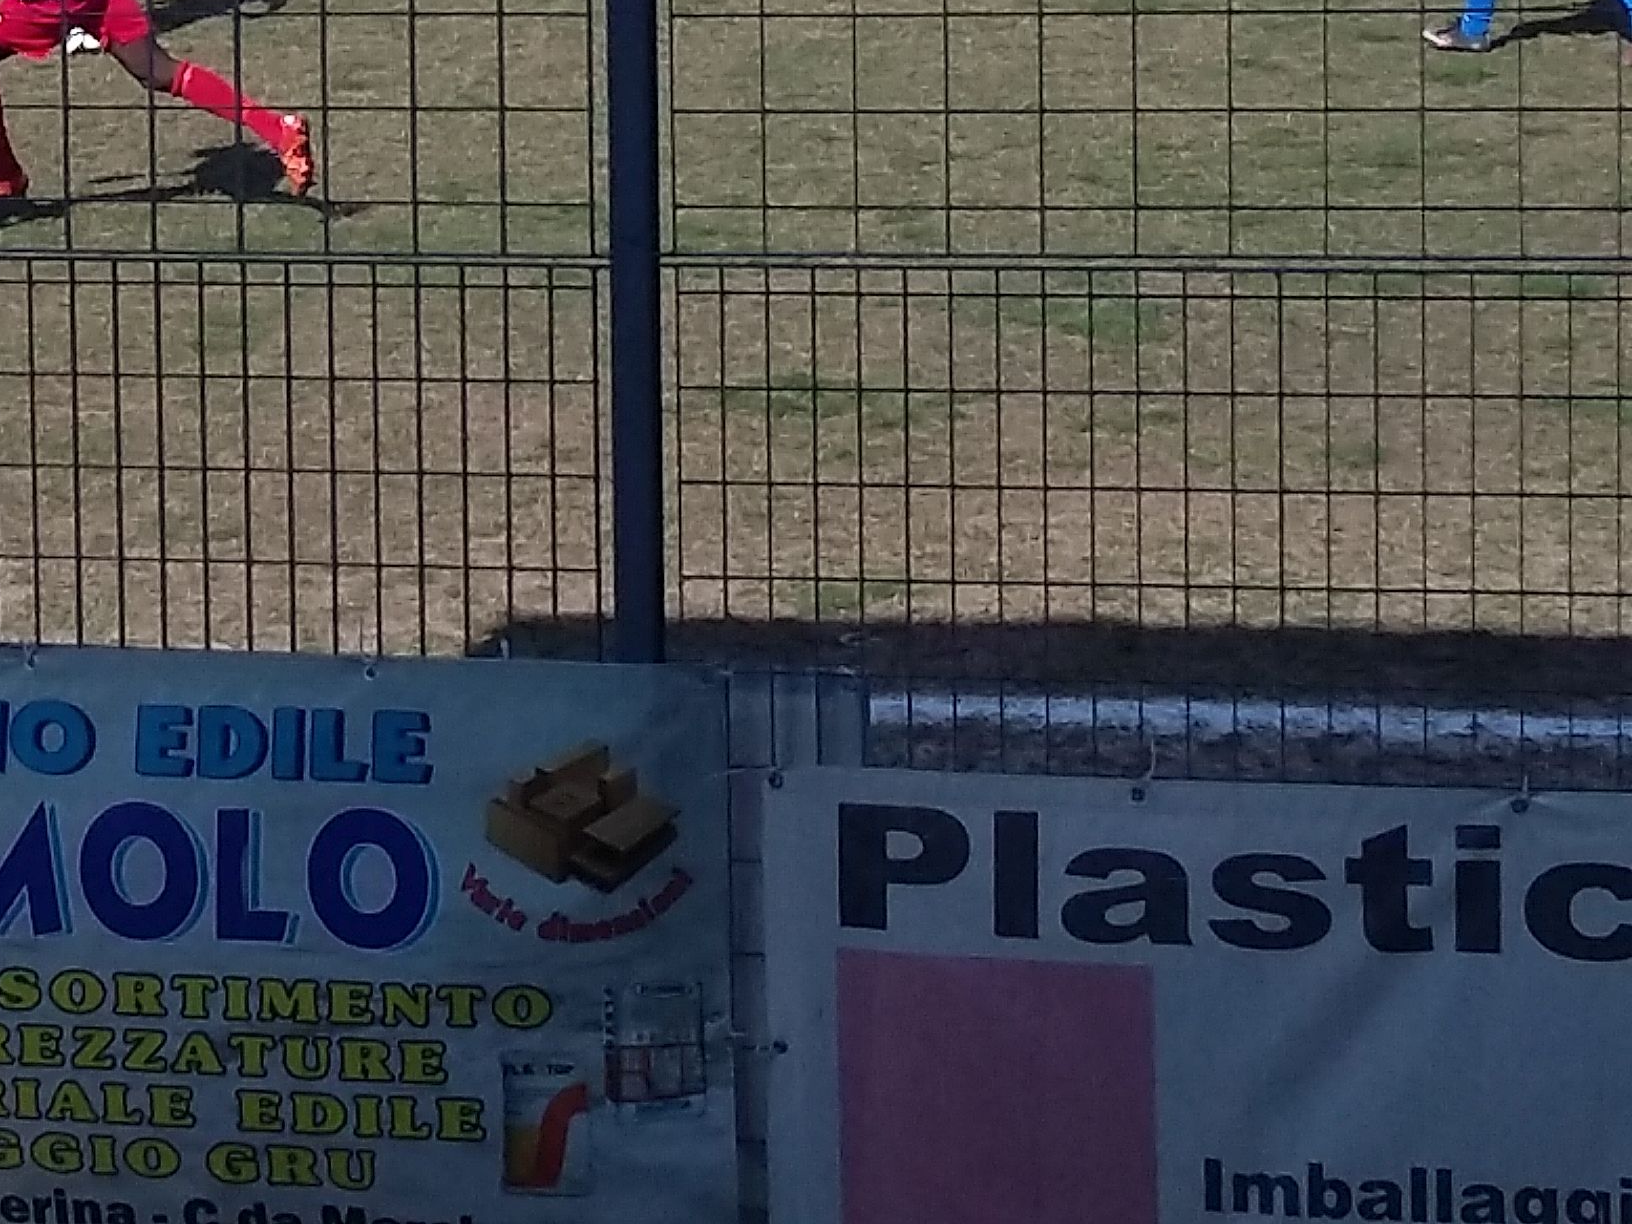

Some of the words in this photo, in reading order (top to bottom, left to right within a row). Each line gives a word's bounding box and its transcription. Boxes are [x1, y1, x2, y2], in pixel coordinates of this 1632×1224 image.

[135, 703, 435, 785] EDILE
[838, 802, 1632, 963] Plastic
[234, 1087, 487, 1142] EDILE
[205, 1140, 376, 1191] GRU
[1203, 1157, 1632, 1224] Imballaggi
